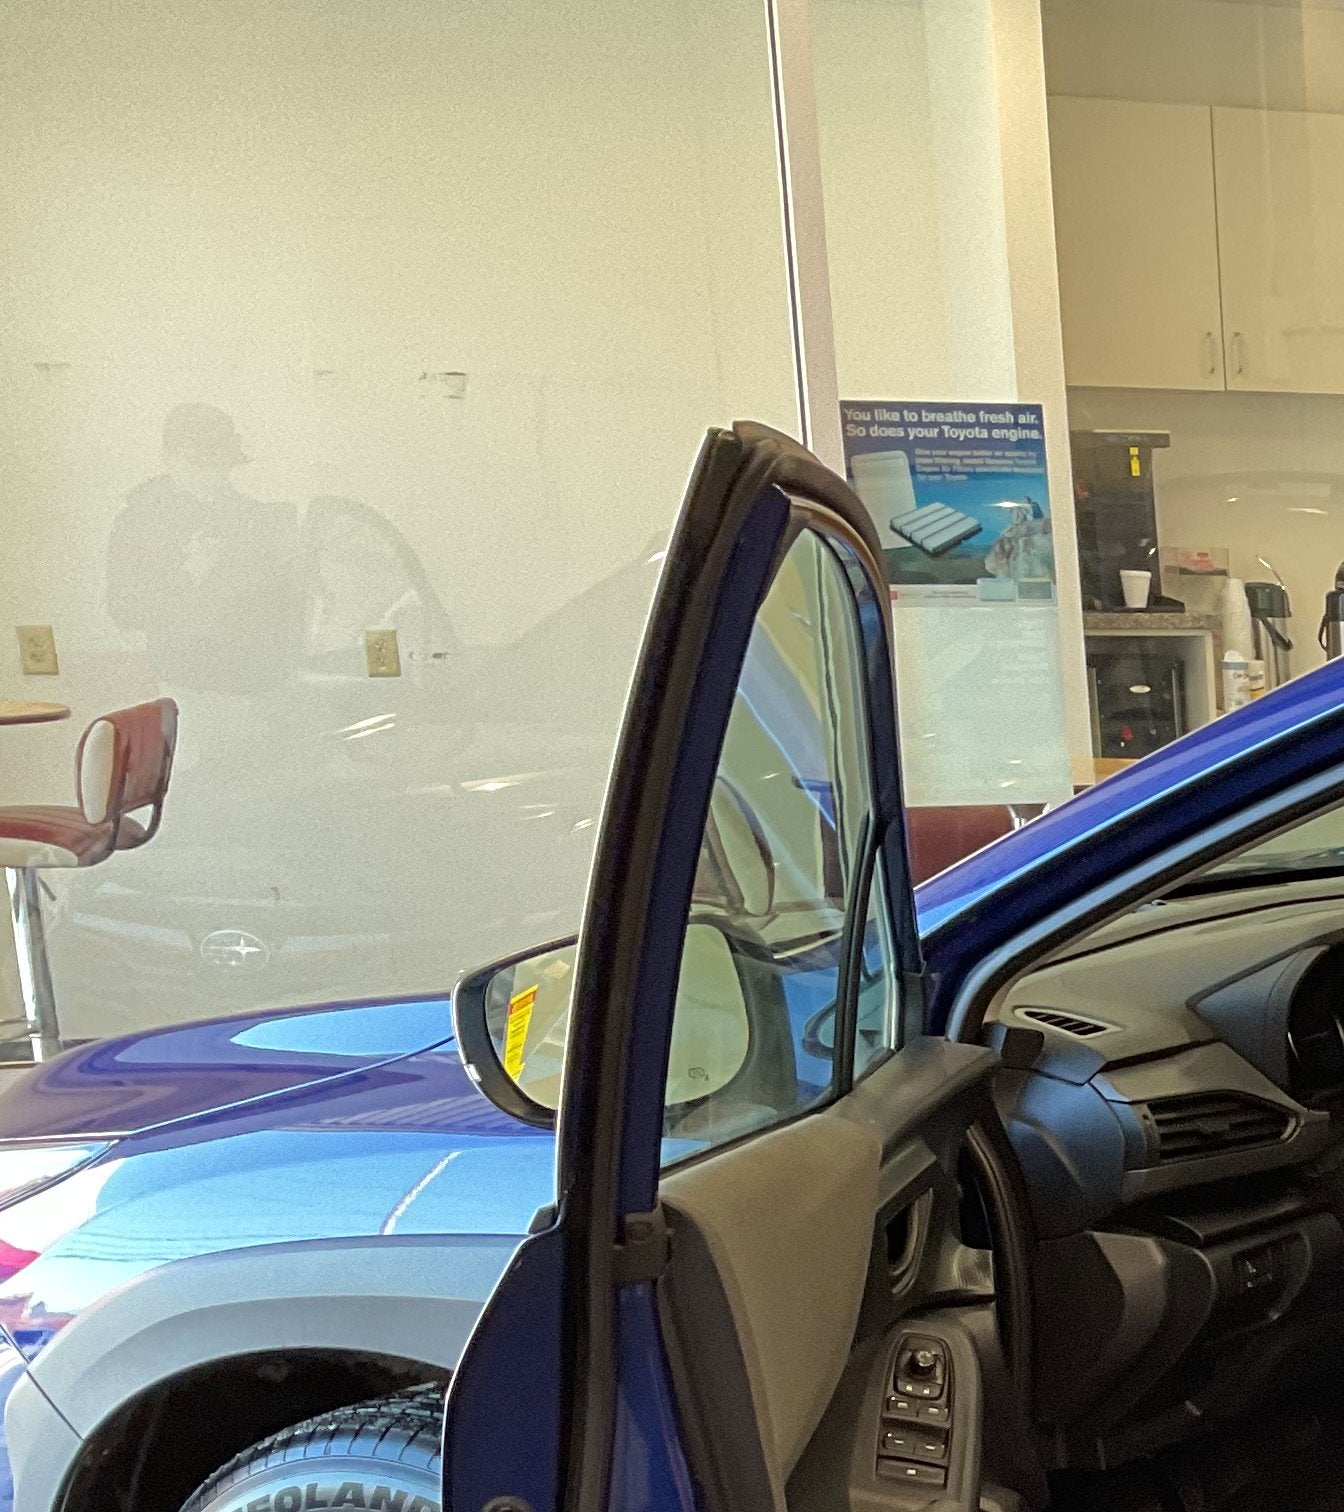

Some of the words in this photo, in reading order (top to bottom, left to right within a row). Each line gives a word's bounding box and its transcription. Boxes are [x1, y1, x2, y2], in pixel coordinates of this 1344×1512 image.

[844, 408, 871, 422] You
[874, 409, 900, 422] like
[903, 410, 918, 422] to
[921, 409, 976, 423] breathe
[979, 410, 1014, 424] fresh
[1017, 411, 1039, 424] air.
[846, 424, 866, 437] So
[869, 424, 904, 438] does
[908, 427, 939, 440] your
[941, 425, 988, 441] Toyota
[991, 427, 1042, 441] engine.
